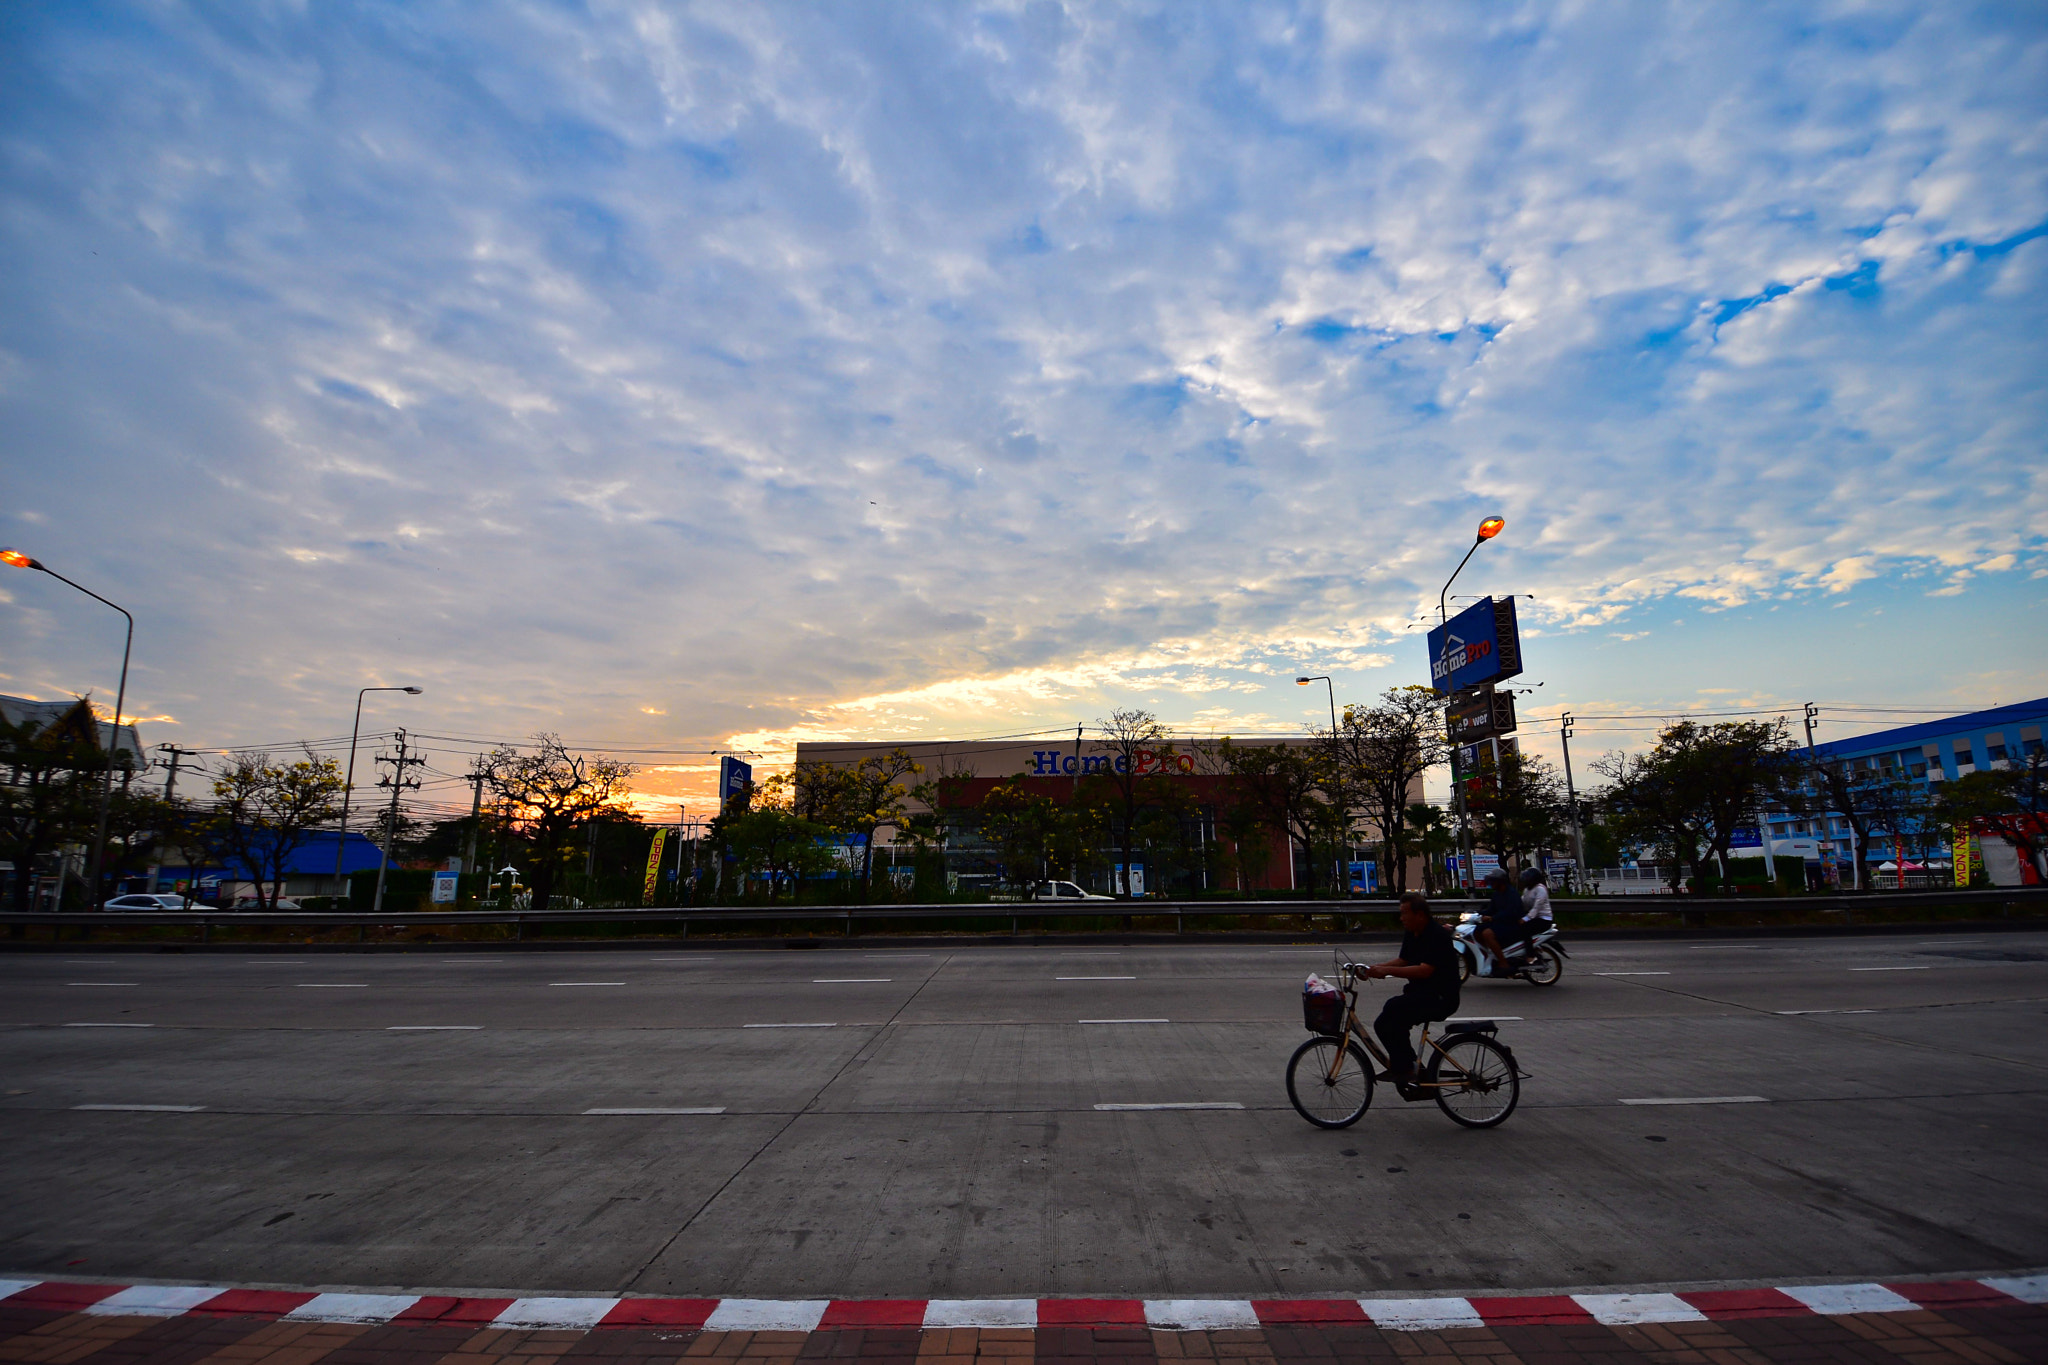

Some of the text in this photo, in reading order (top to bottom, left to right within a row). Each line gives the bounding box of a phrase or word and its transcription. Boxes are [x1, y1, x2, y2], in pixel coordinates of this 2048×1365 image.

[1432, 640, 1491, 680] HomePro
[1033, 750, 1194, 775] HomePro
[648, 837, 663, 870] OPEN
